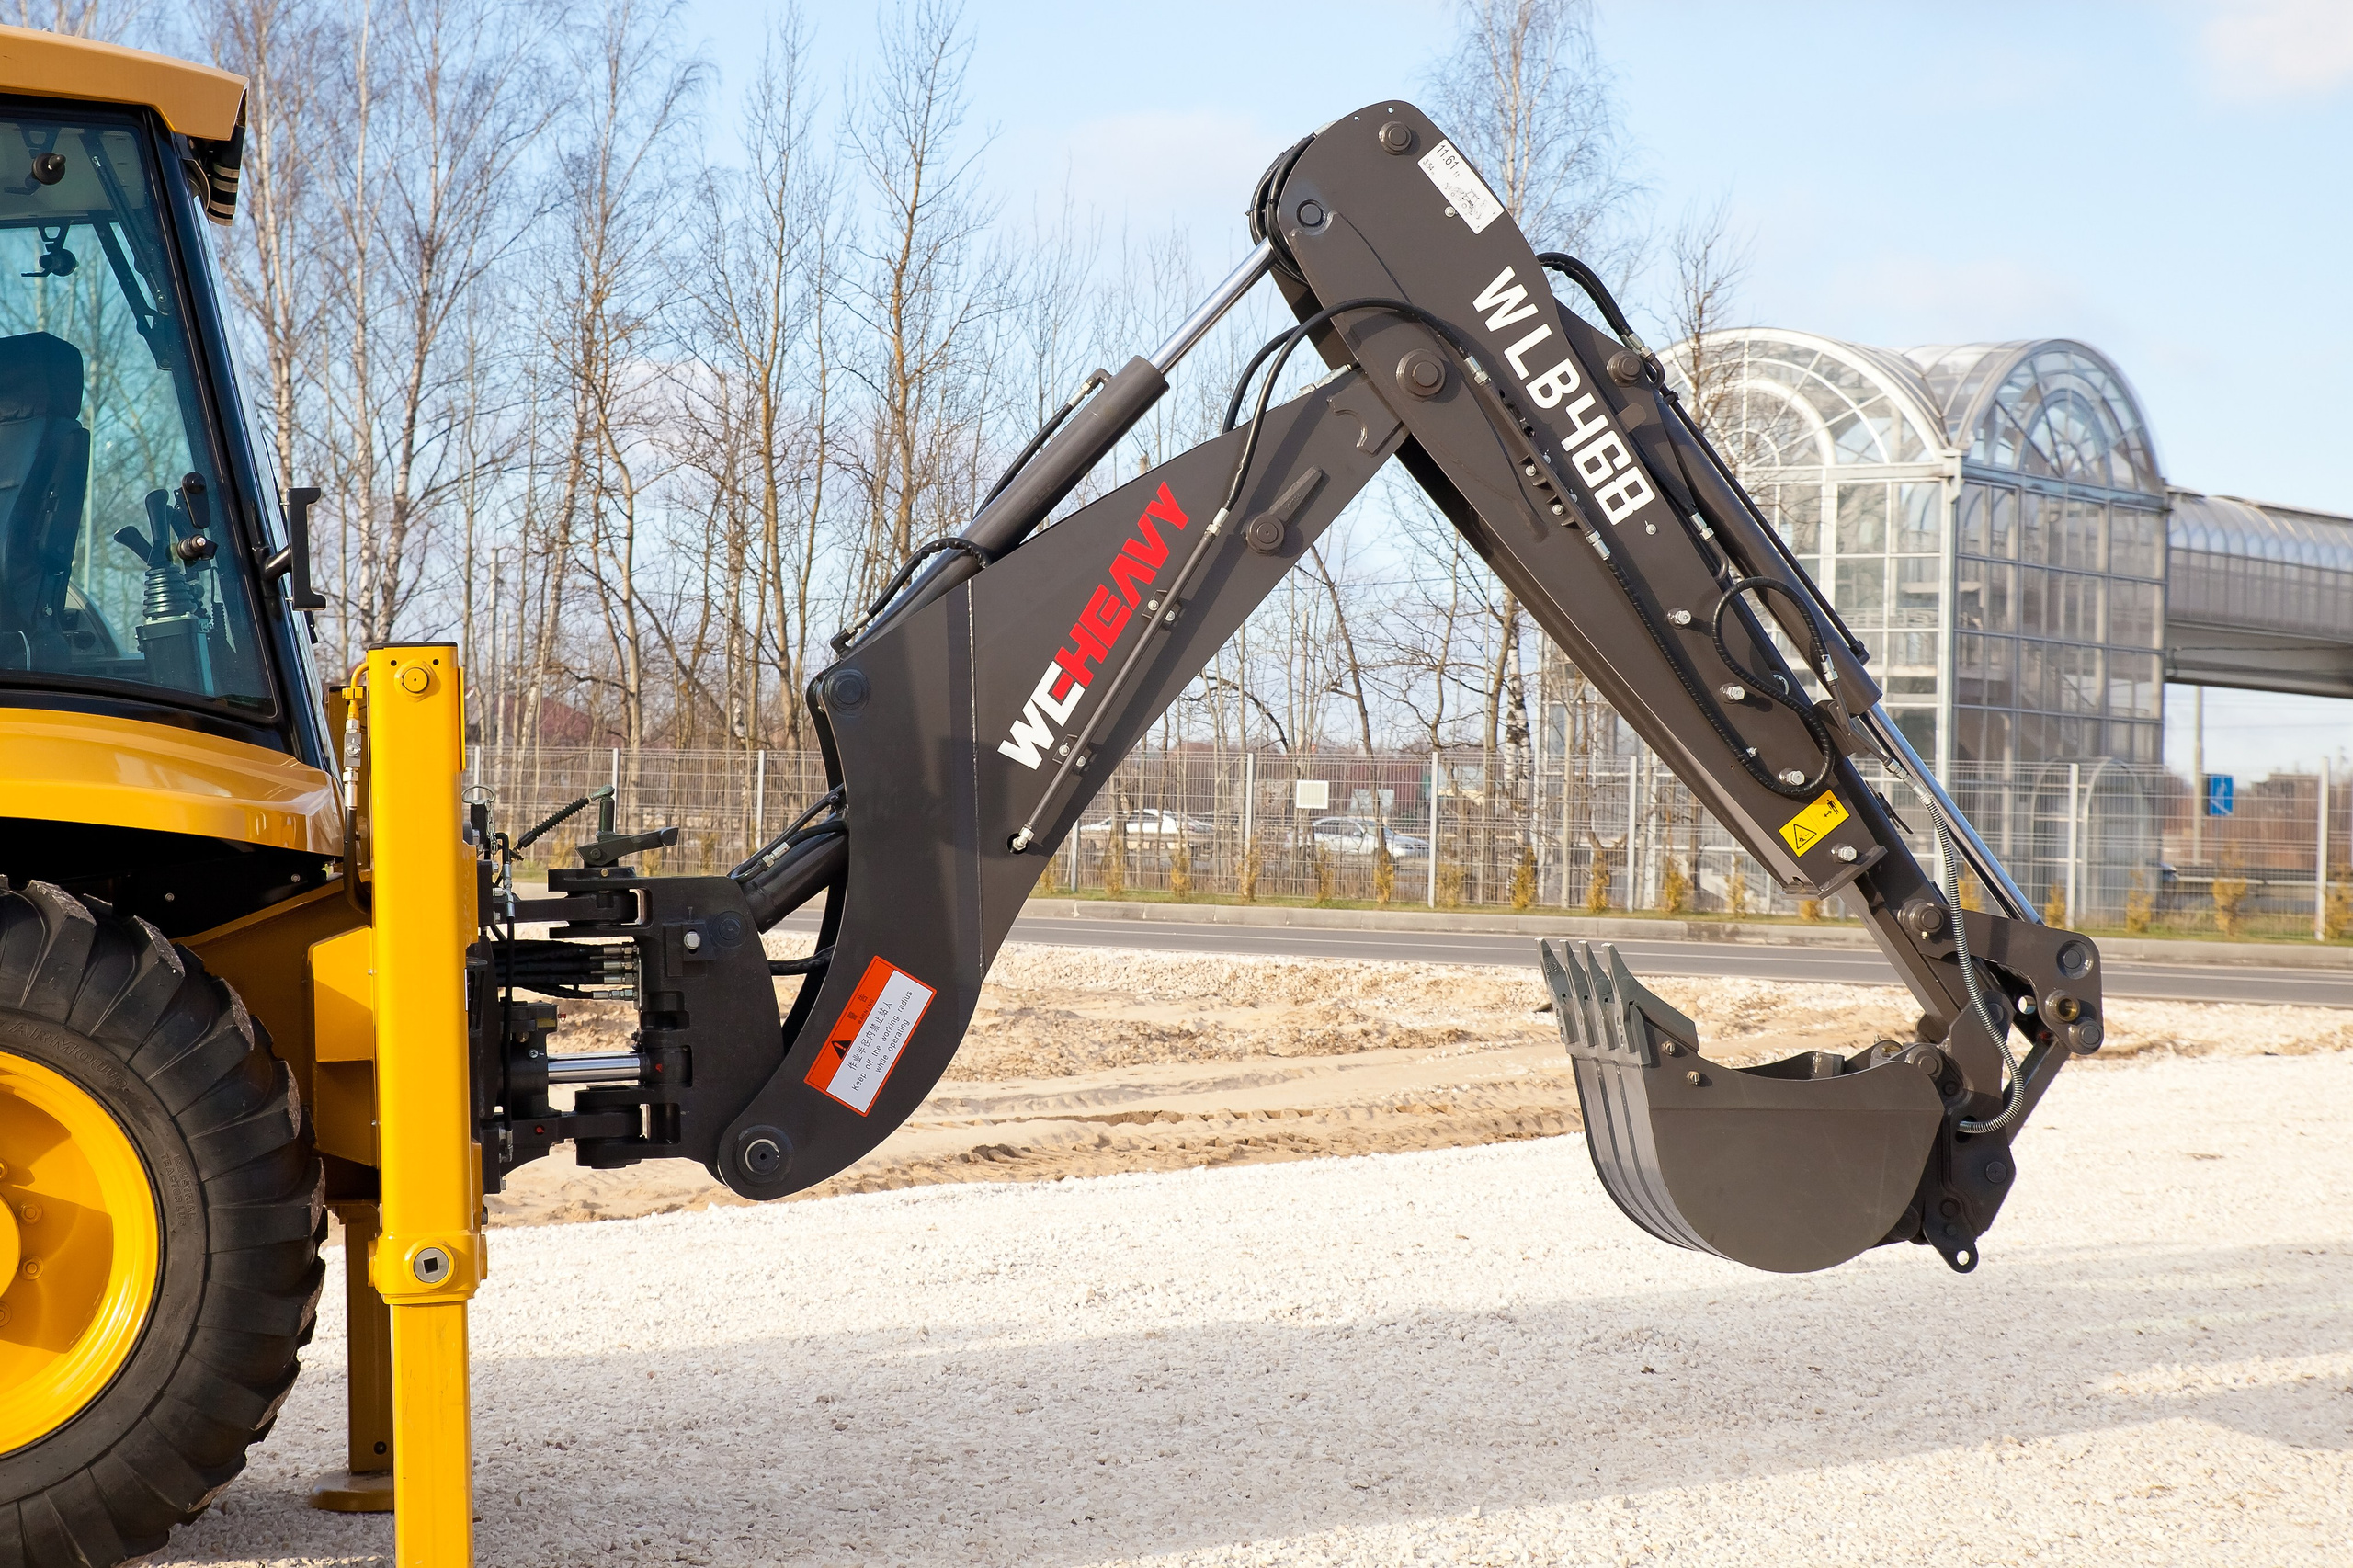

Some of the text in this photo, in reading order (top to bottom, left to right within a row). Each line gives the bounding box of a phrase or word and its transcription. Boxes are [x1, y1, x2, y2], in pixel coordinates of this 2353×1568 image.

[1422, 158, 1435, 171] 3.54
[1436, 144, 1460, 170] 11.61
[1472, 265, 1655, 526] WLB468
[847, 1000, 893, 1071] 作业半径内禁止站人
[851, 990, 913, 1091] Keep off the working radius
[857, 998, 874, 1025] WARNING
[7, 1021, 128, 1090] ARMOUR
[875, 1018, 911, 1074] while operating
[160, 1152, 183, 1204] TRACTOR
[173, 1153, 197, 1220] INDUSTRIAL
